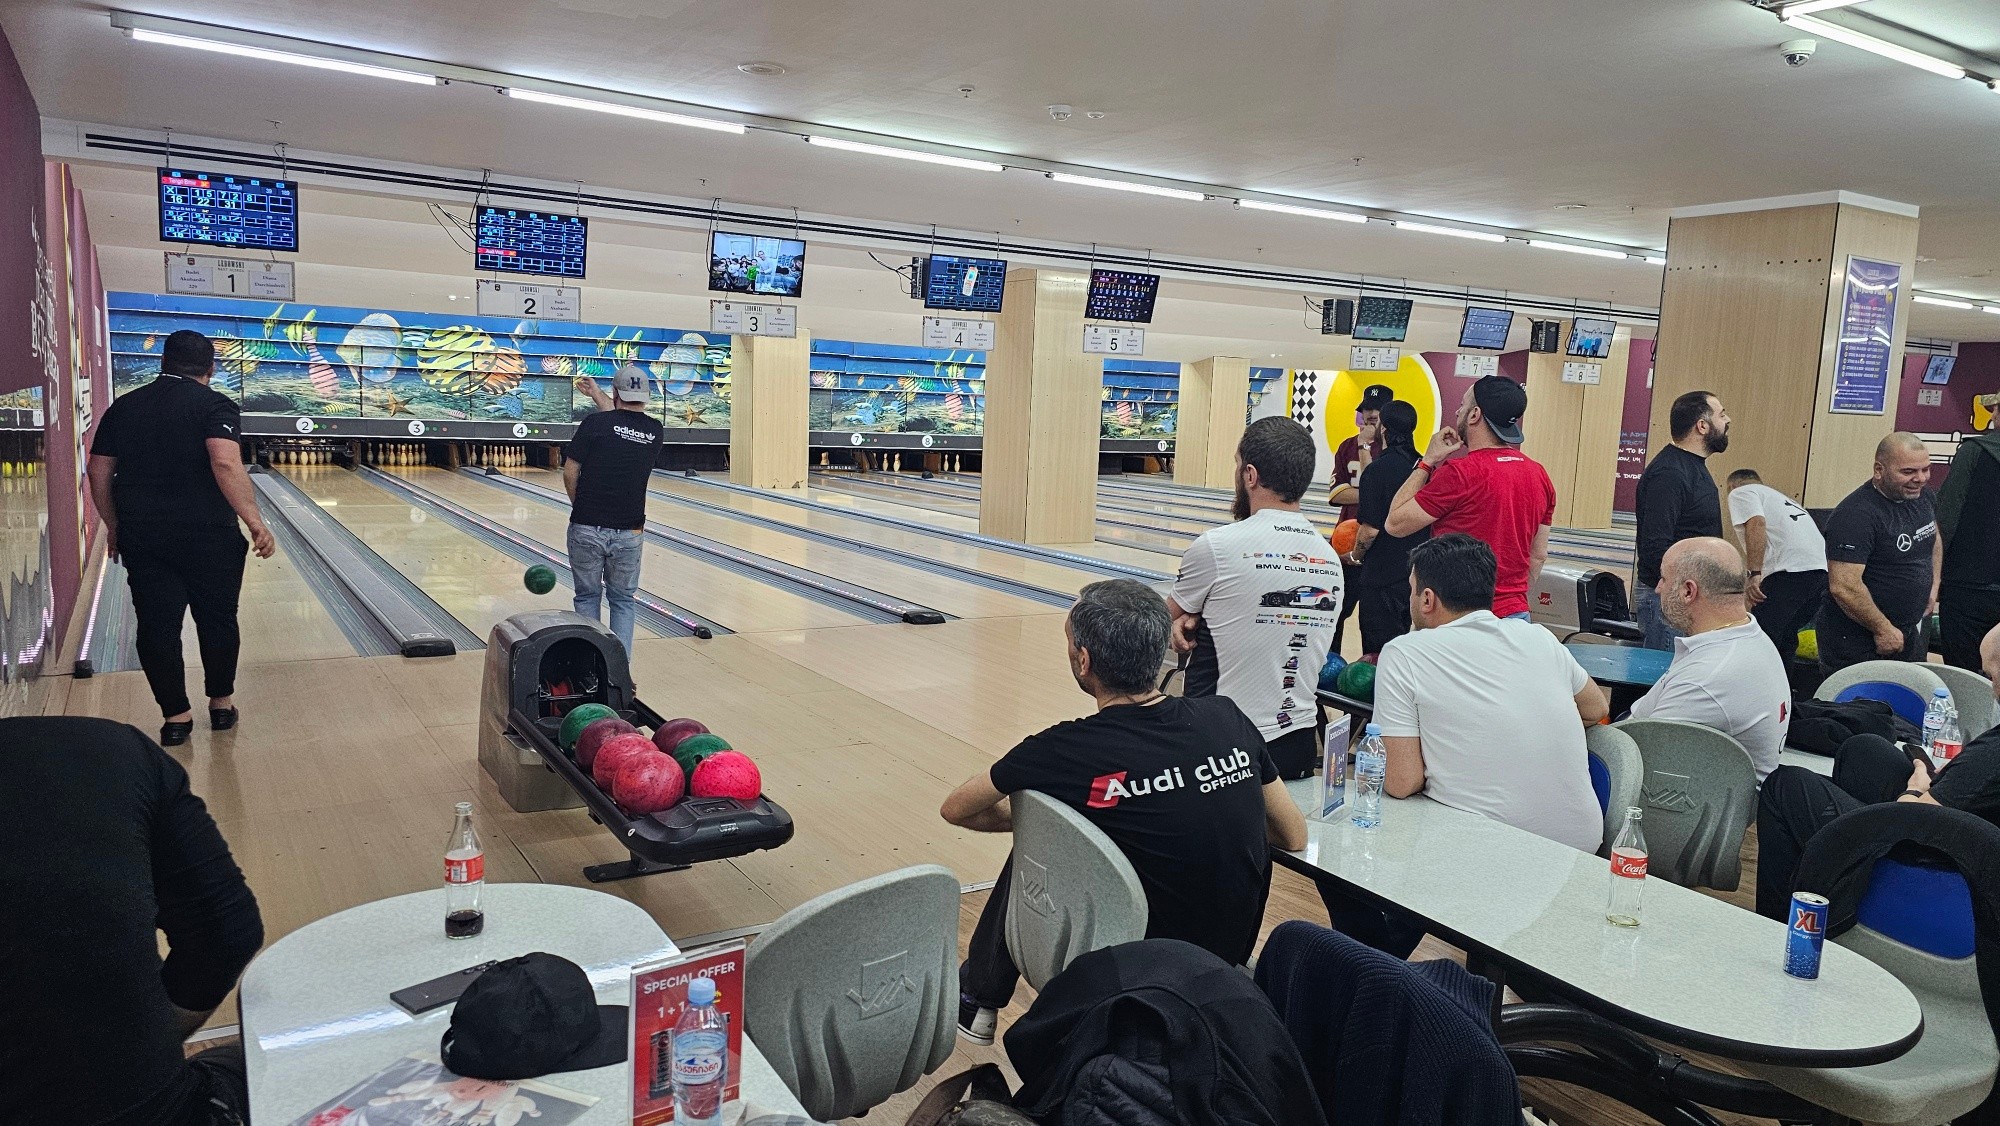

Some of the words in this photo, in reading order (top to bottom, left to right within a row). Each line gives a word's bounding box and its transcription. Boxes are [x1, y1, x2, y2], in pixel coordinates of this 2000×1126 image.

[197, 198, 209, 206] 22
[228, 274, 235, 292] 1
[524, 298, 536, 314] 2
[749, 316, 758, 332] 3
[954, 332, 963, 346] 4
[1110, 338, 1118, 350] 5
[1371, 356, 1376, 368] 6
[1474, 364, 1478, 374] 7
[630, 377, 640, 389] H
[301, 422, 309, 430] 2
[414, 424, 420, 433] 3
[517, 427, 524, 435] 4
[613, 425, 645, 439] adidas
[1309, 568, 1339, 577] GEORGIA
[1104, 766, 1185, 801] Audi
[1194, 748, 1250, 782] club
[1200, 769, 1254, 794] OFFICIAL
[1794, 908, 1821, 933] XL
[698, 961, 736, 978] OFFER
